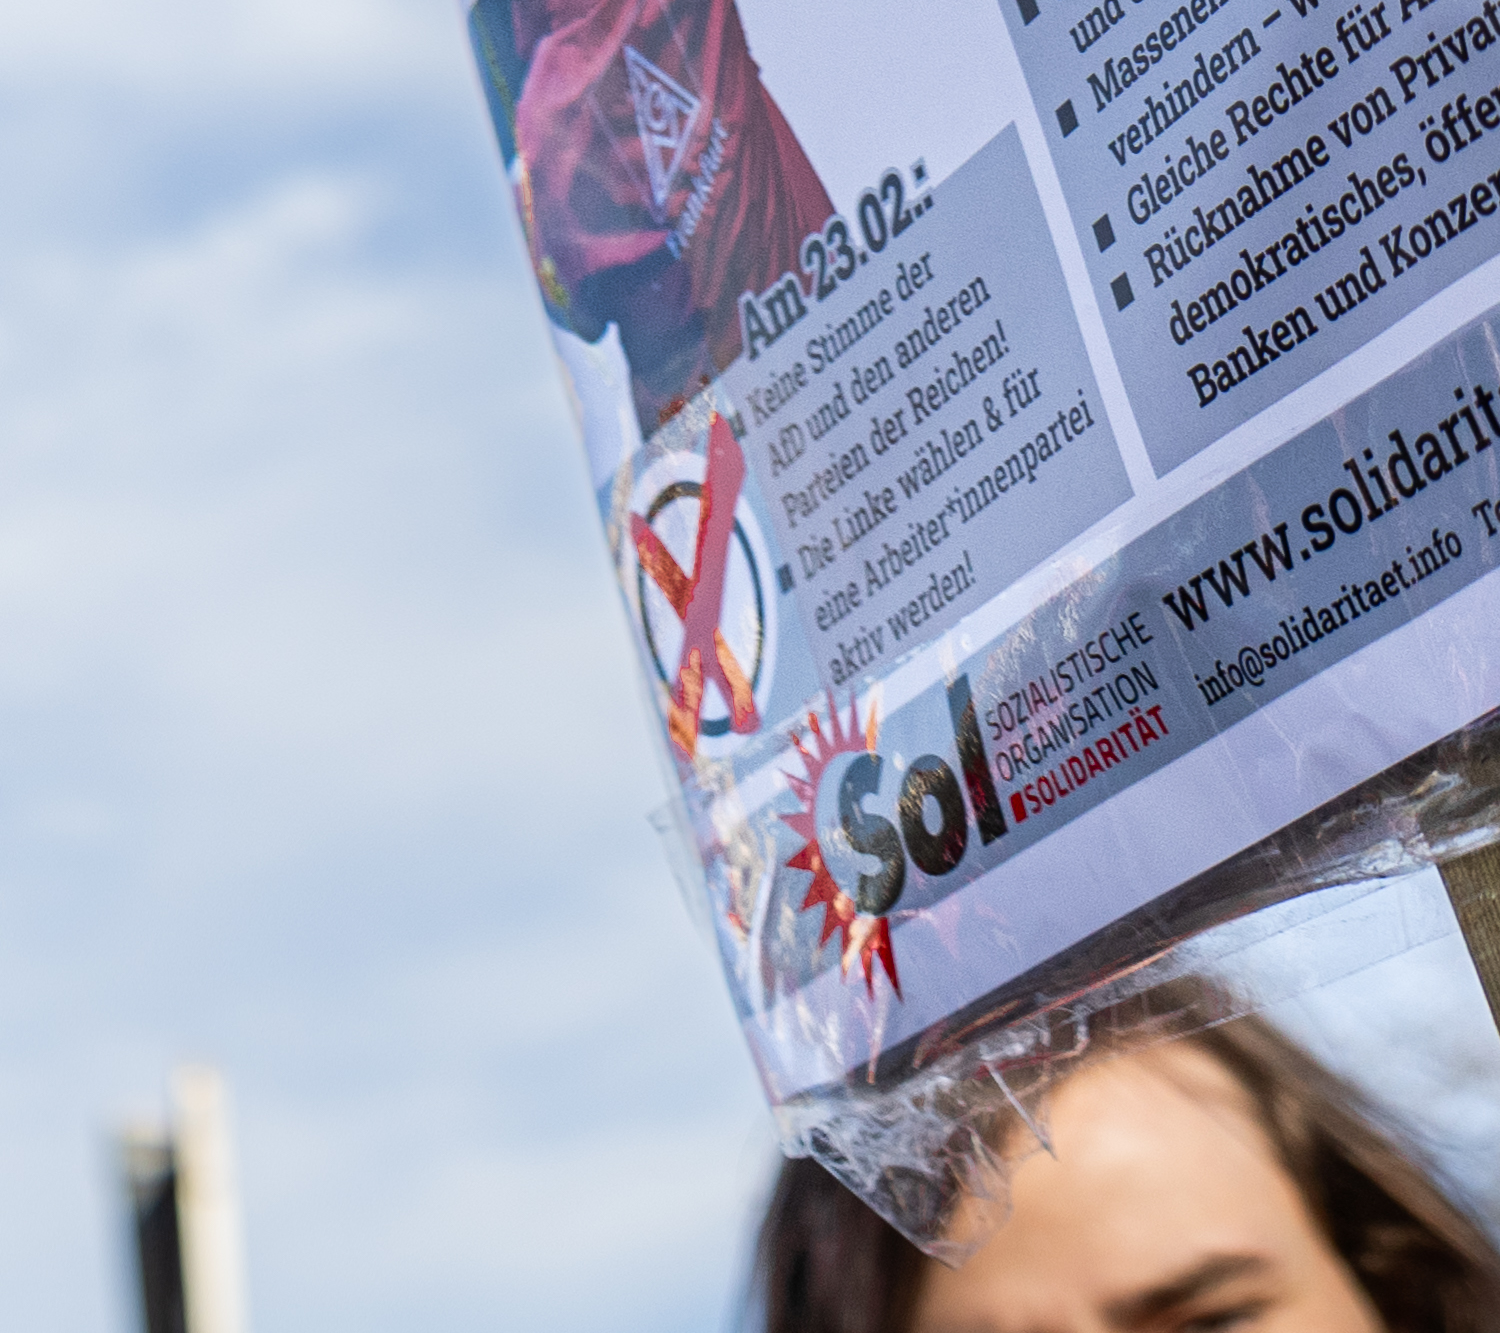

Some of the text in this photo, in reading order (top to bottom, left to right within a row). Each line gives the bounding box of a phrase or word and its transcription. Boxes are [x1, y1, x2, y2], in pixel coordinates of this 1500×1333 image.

[1108, 28, 1261, 165] verhindern
[1127, 129, 1229, 224] Gleiche
[1225, 47, 1338, 145] Rechte
[1336, 2, 1391, 63] für
[742, 162, 934, 361] Am 23.02.:
[1143, 135, 1329, 287] Rücknahme
[1327, 87, 1396, 147] von
[1169, 153, 1426, 345] demokratisches,
[746, 252, 934, 425] Keine Stimme der
[768, 276, 991, 477] AfD und den anderen
[1187, 307, 1318, 407] Banken
[1314, 246, 1386, 321] und
[781, 319, 1009, 528] Parteien der Reichen!
[797, 368, 1041, 581] Die Linke wählen & für
[815, 581, 861, 631] eine
[829, 549, 975, 686] aktiv werden!
[985, 611, 1153, 741] SOZIALISTISCHE
[1194, 528, 1462, 706] info@solidaritaet.info
[837, 672, 1008, 917] Sol
[995, 661, 1159, 781] ORGANISATION
[1025, 703, 1171, 815] SOLIDARITÄT
